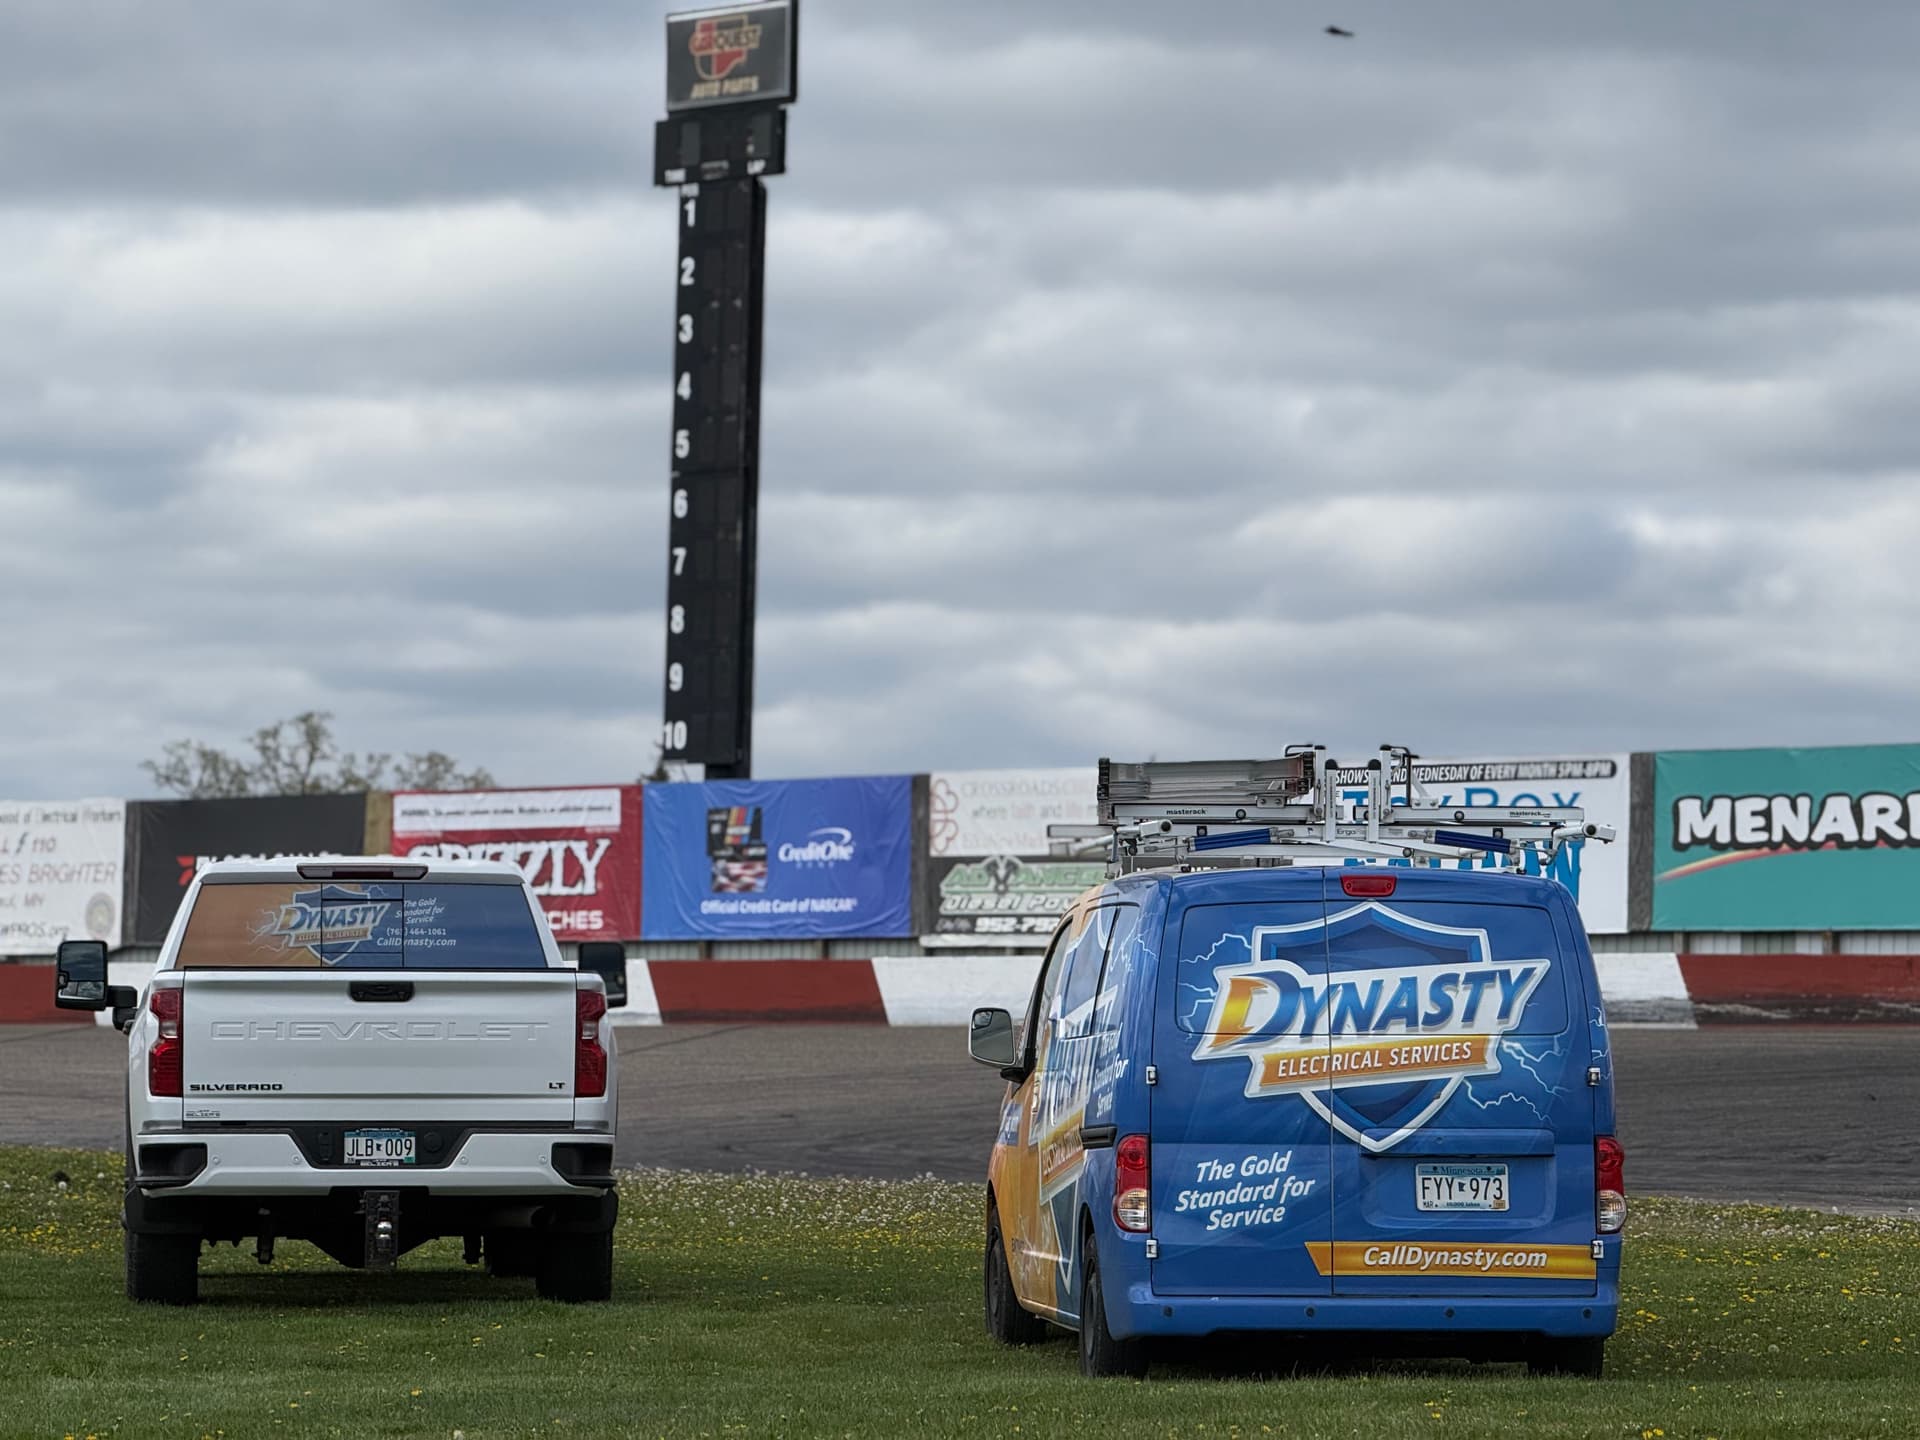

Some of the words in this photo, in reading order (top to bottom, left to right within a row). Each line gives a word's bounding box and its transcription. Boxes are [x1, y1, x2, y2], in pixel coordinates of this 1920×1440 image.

[684, 199, 696, 227] 1
[680, 256, 695, 286] 2
[678, 314, 693, 343] 3
[677, 371, 691, 400] 4
[675, 429, 690, 459] 5
[673, 489, 688, 518] 6
[673, 547, 687, 575] 7
[670, 605, 685, 634] 8
[669, 662, 683, 692] 9
[664, 720, 687, 750] 10
[1336, 769, 1369, 785] SHOWS
[1412, 764, 1468, 782] WEDNESDAY
[1469, 765, 1483, 780] OF
[1484, 763, 1517, 780] EVERY
[1166, 808, 1207, 816] masterack
[281, 904, 387, 931] DYNASTY
[395, 906, 432, 918] Sandard
[701, 899, 739, 914] Official
[740, 899, 772, 914] Credit
[773, 898, 798, 913] Card
[798, 898, 810, 913] of
[376, 937, 457, 948] CallDnasty.com
[386, 927, 408, 937] (76)
[409, 927, 447, 936] 464-1061
[1208, 967, 1539, 1049] DYNASTY
[210, 1021, 550, 1041] CHEVROLET
[1276, 1048, 1384, 1078] ELECTRICAL
[1388, 1041, 1473, 1068] SERVICES
[189, 1083, 283, 1092] SILVERADO
[549, 1081, 566, 1090] LT
[346, 1138, 374, 1157] JLB
[385, 1138, 413, 1157] 009
[1196, 1158, 1236, 1183] The
[1240, 1150, 1293, 1177] Gold
[1440, 1166, 1484, 1176] Minnesota
[1175, 1177, 1280, 1212] Standard
[1279, 1175, 1316, 1204] for
[1421, 1177, 1455, 1200] FYY
[1469, 1177, 1503, 1201] 973
[1206, 1204, 1286, 1231] Service
[1363, 1245, 1548, 1272] CallDynasty.com
